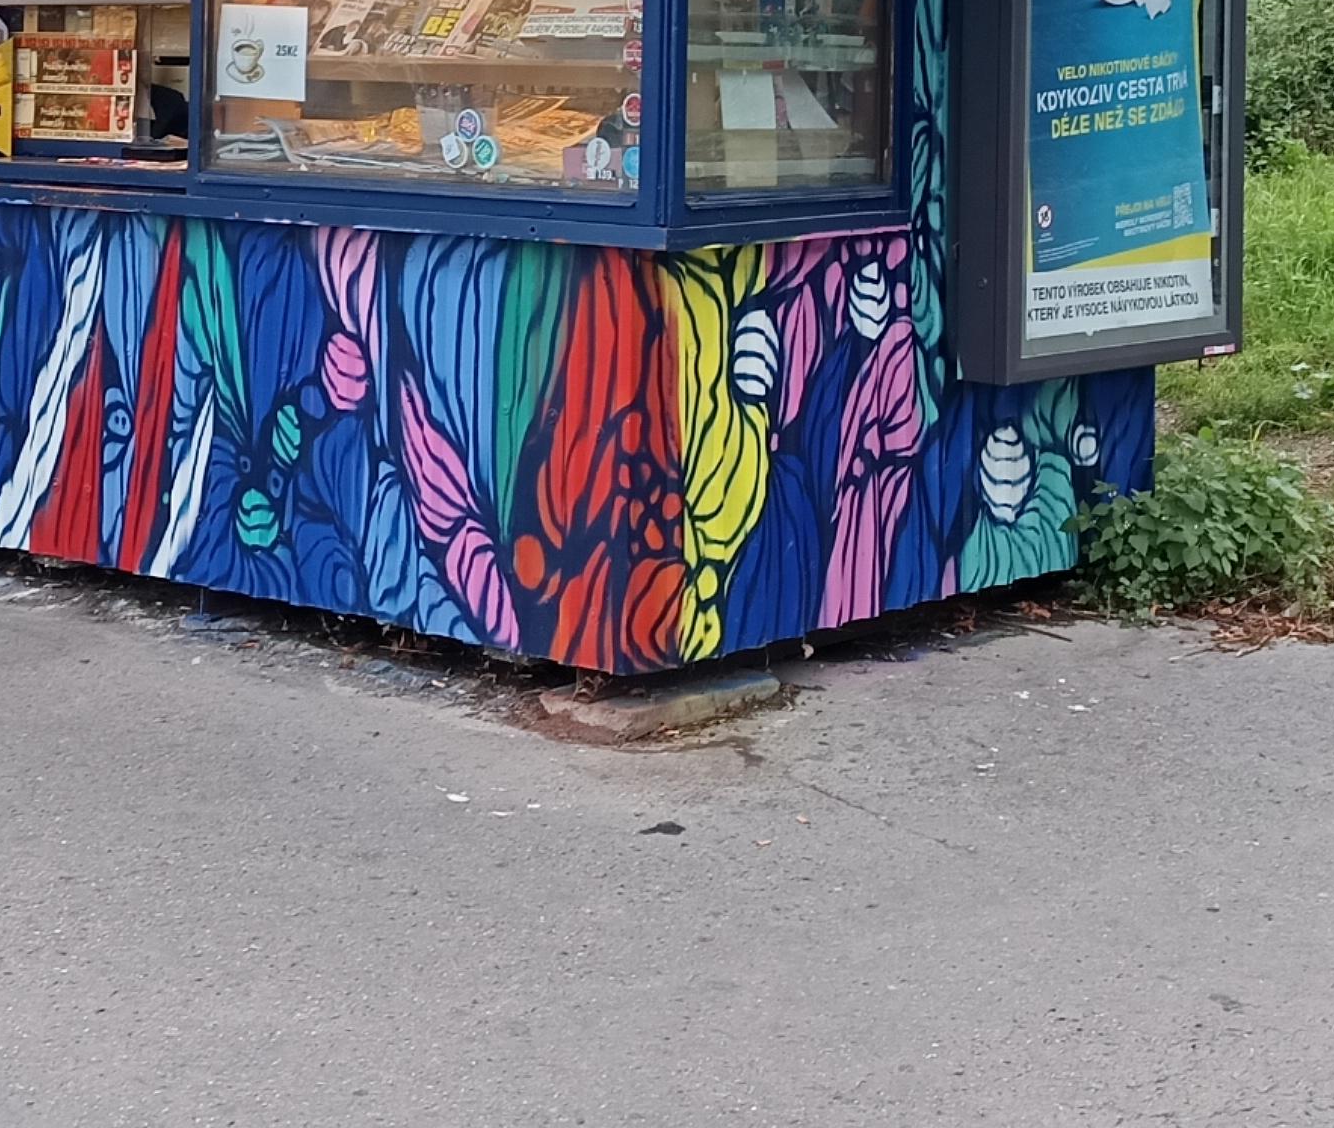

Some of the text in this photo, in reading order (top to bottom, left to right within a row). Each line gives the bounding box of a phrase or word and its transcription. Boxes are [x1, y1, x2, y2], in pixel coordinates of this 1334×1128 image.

[1057, 64, 1087, 81] VELO
[1088, 55, 1149, 77] NIKOTINOVÉ
[1037, 83, 1114, 113] KDYKOLIV
[1117, 75, 1164, 101] CESTA
[1051, 112, 1090, 140] DÉLE
[1094, 104, 1124, 132] NEŽ
[1127, 105, 1147, 126] SE
[1032, 285, 1066, 301] TENTO
[1067, 280, 1106, 299] VÝROBEK
[1107, 277, 1152, 293] OBSAHUJE
[1027, 291, 1199, 322] KTERÝ JE VYSOCE NÁVYKOVOU LÁTKOU
